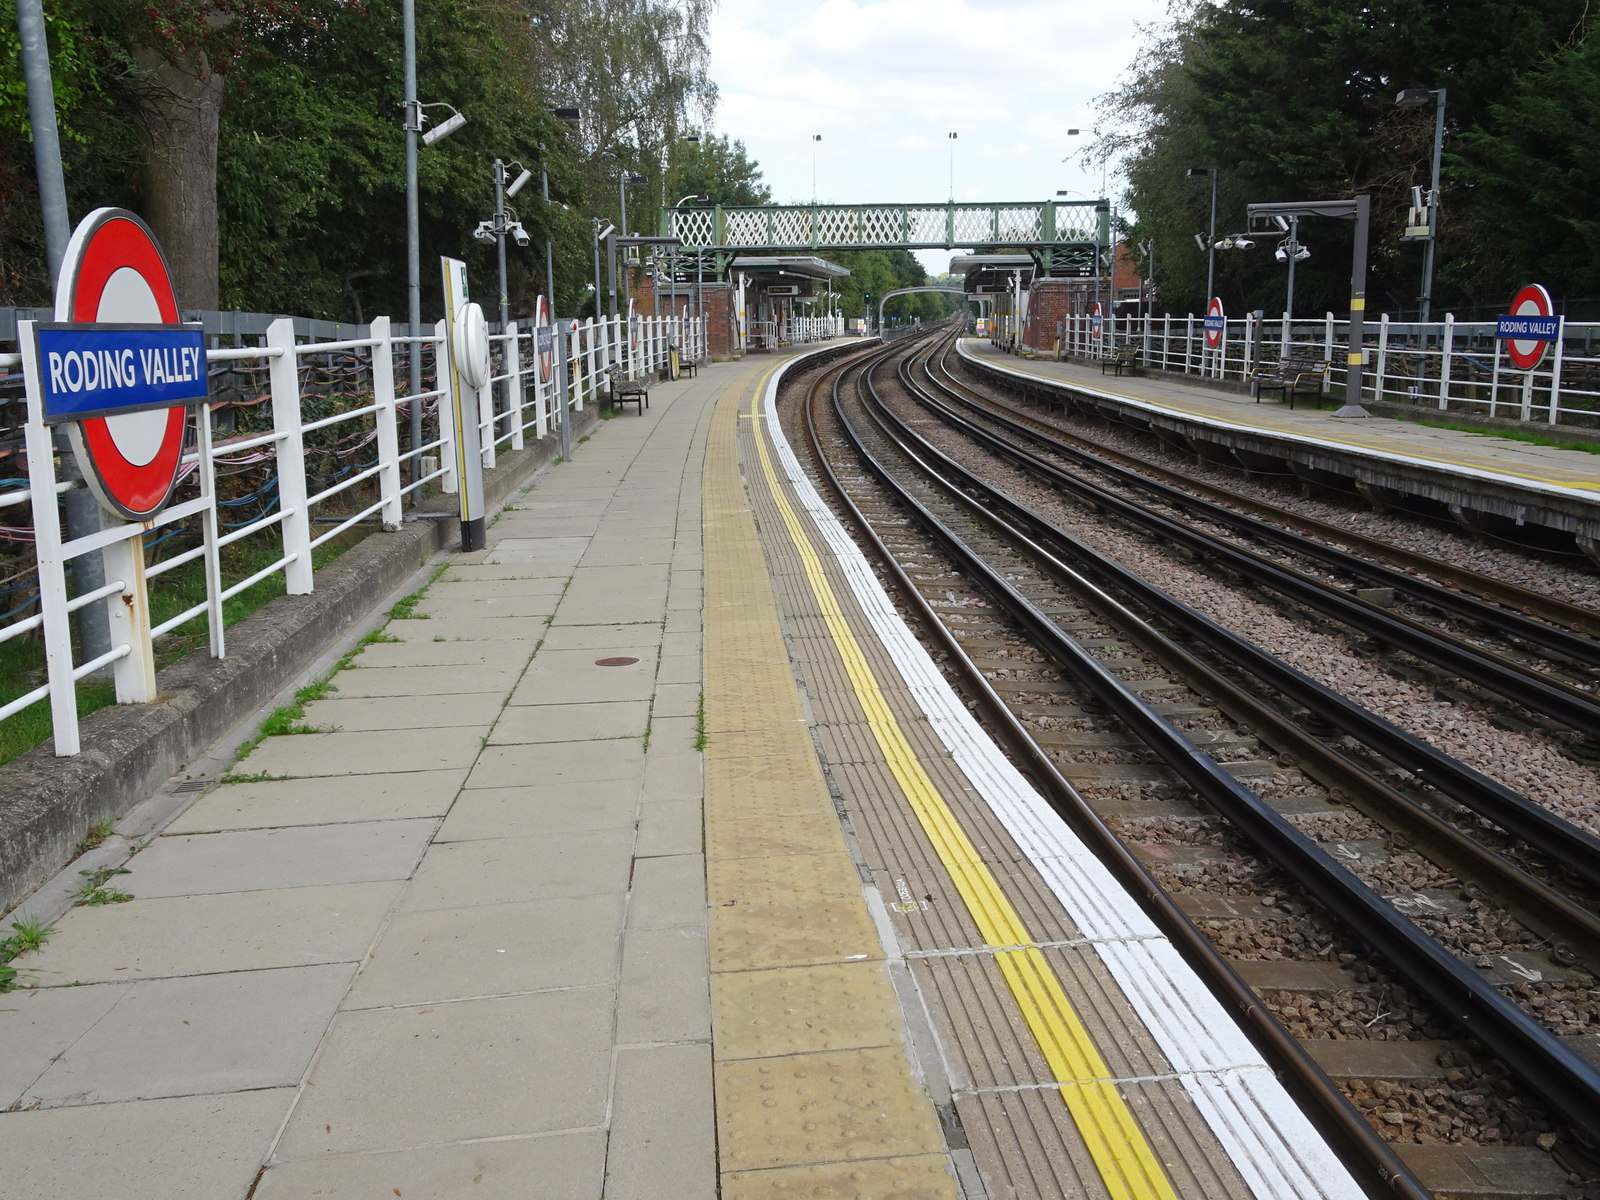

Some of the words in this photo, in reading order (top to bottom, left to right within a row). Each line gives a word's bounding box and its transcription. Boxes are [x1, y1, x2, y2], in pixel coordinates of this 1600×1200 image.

[1500, 321, 1527, 333] RODING
[1529, 323, 1557, 335] VALLEY
[48, 349, 136, 394] RODING
[139, 347, 200, 385] VALLEY
